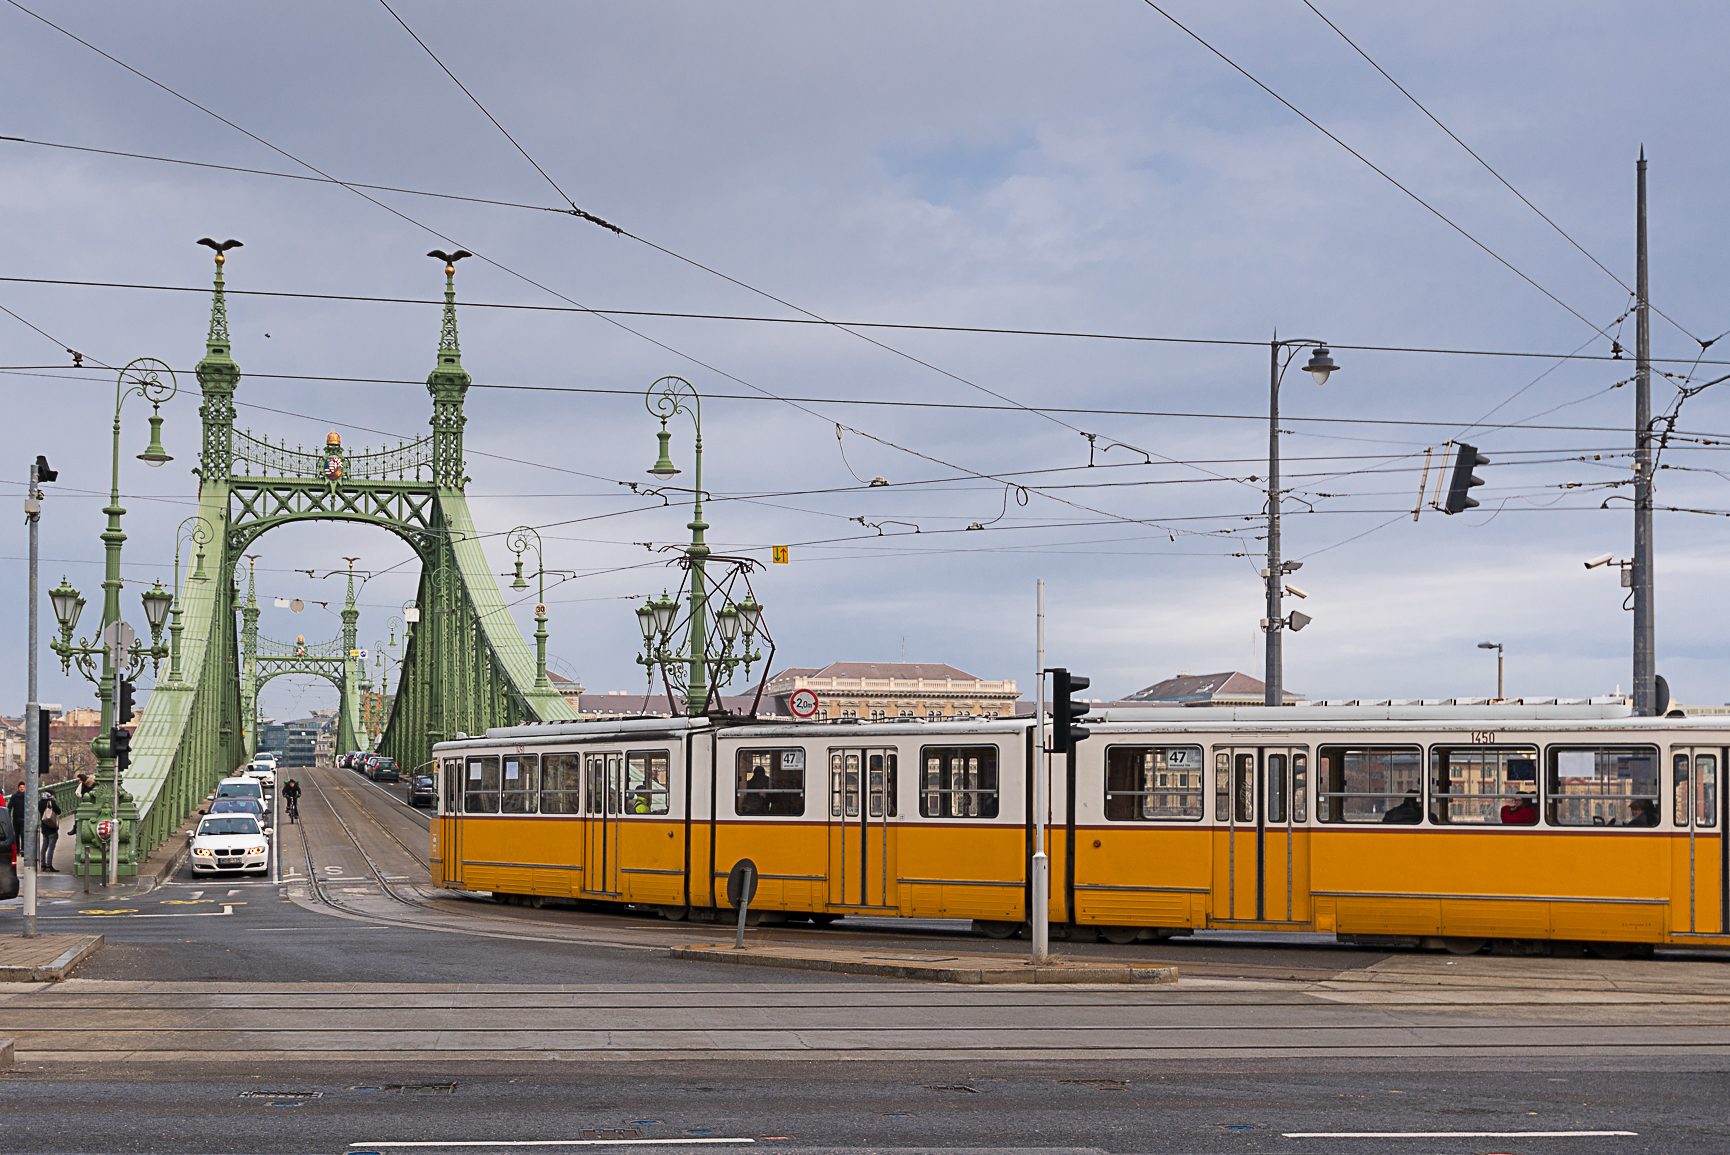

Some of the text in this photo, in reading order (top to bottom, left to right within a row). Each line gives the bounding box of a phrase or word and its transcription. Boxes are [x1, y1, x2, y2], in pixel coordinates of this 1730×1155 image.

[1471, 731, 1495, 743] 1450
[783, 753, 796, 764] 47
[1169, 751, 1187, 763] 47
